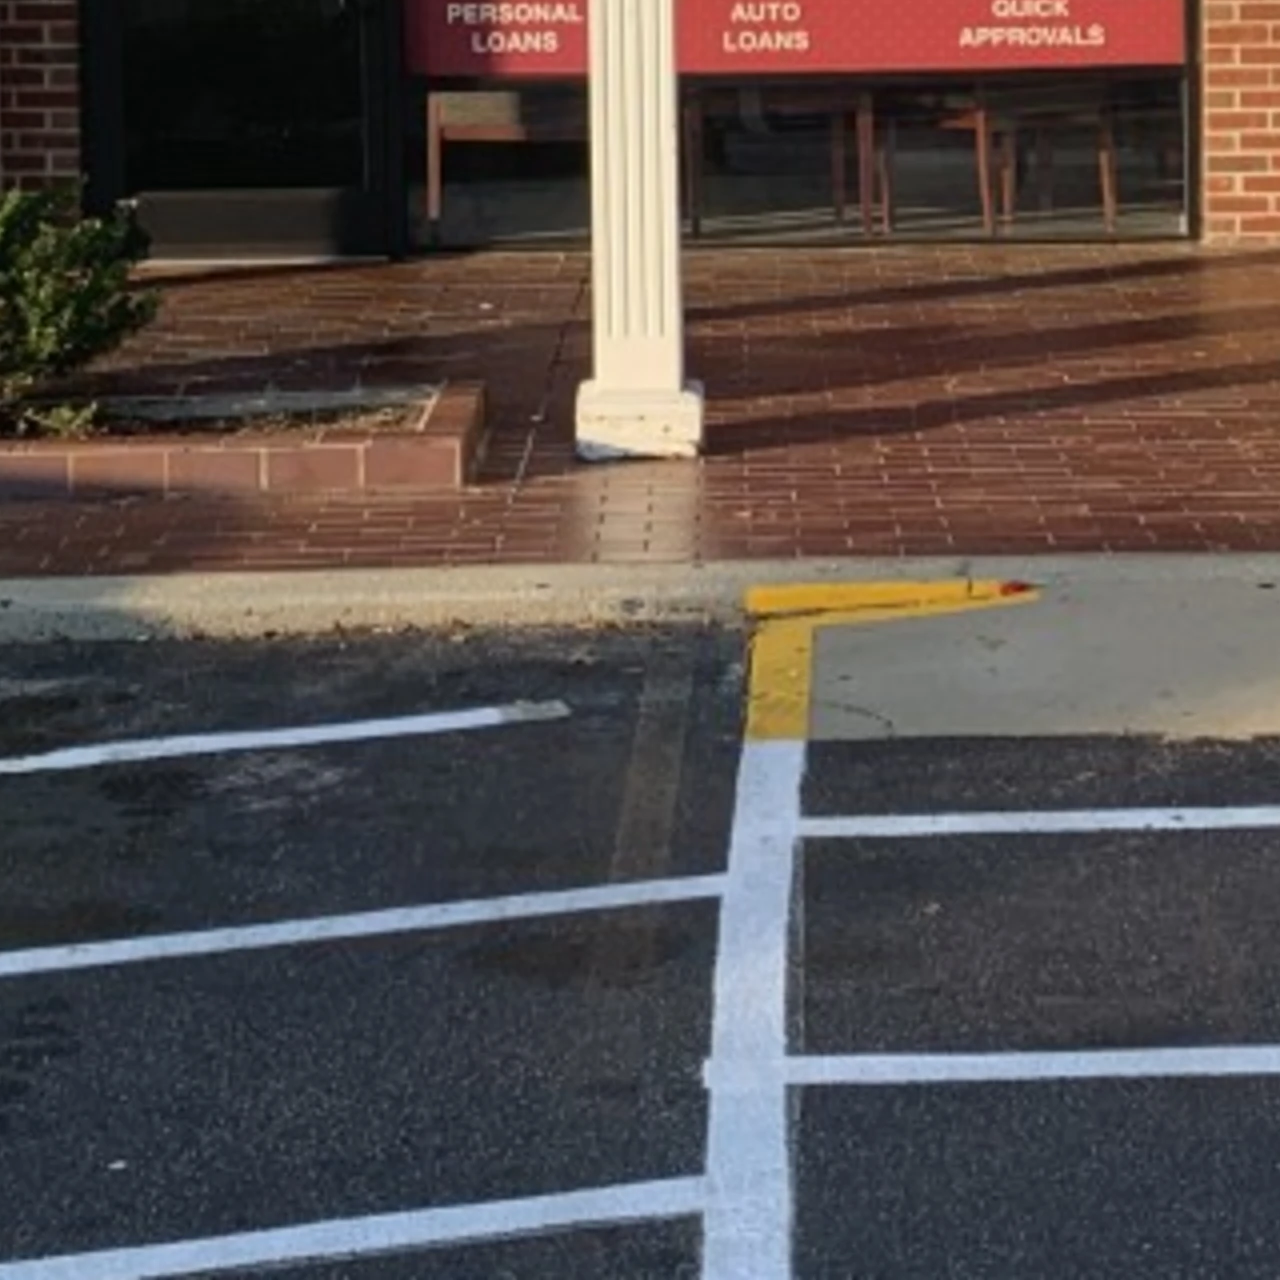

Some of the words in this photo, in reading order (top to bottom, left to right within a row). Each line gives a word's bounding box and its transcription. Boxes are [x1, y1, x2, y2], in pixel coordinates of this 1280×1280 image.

[446, 2, 584, 25] PERSONAL
[730, 0, 802, 23] AUTO
[471, 30, 559, 54] LOANS
[722, 29, 810, 53] LOANS
[959, 22, 1106, 48] APPROVALS
